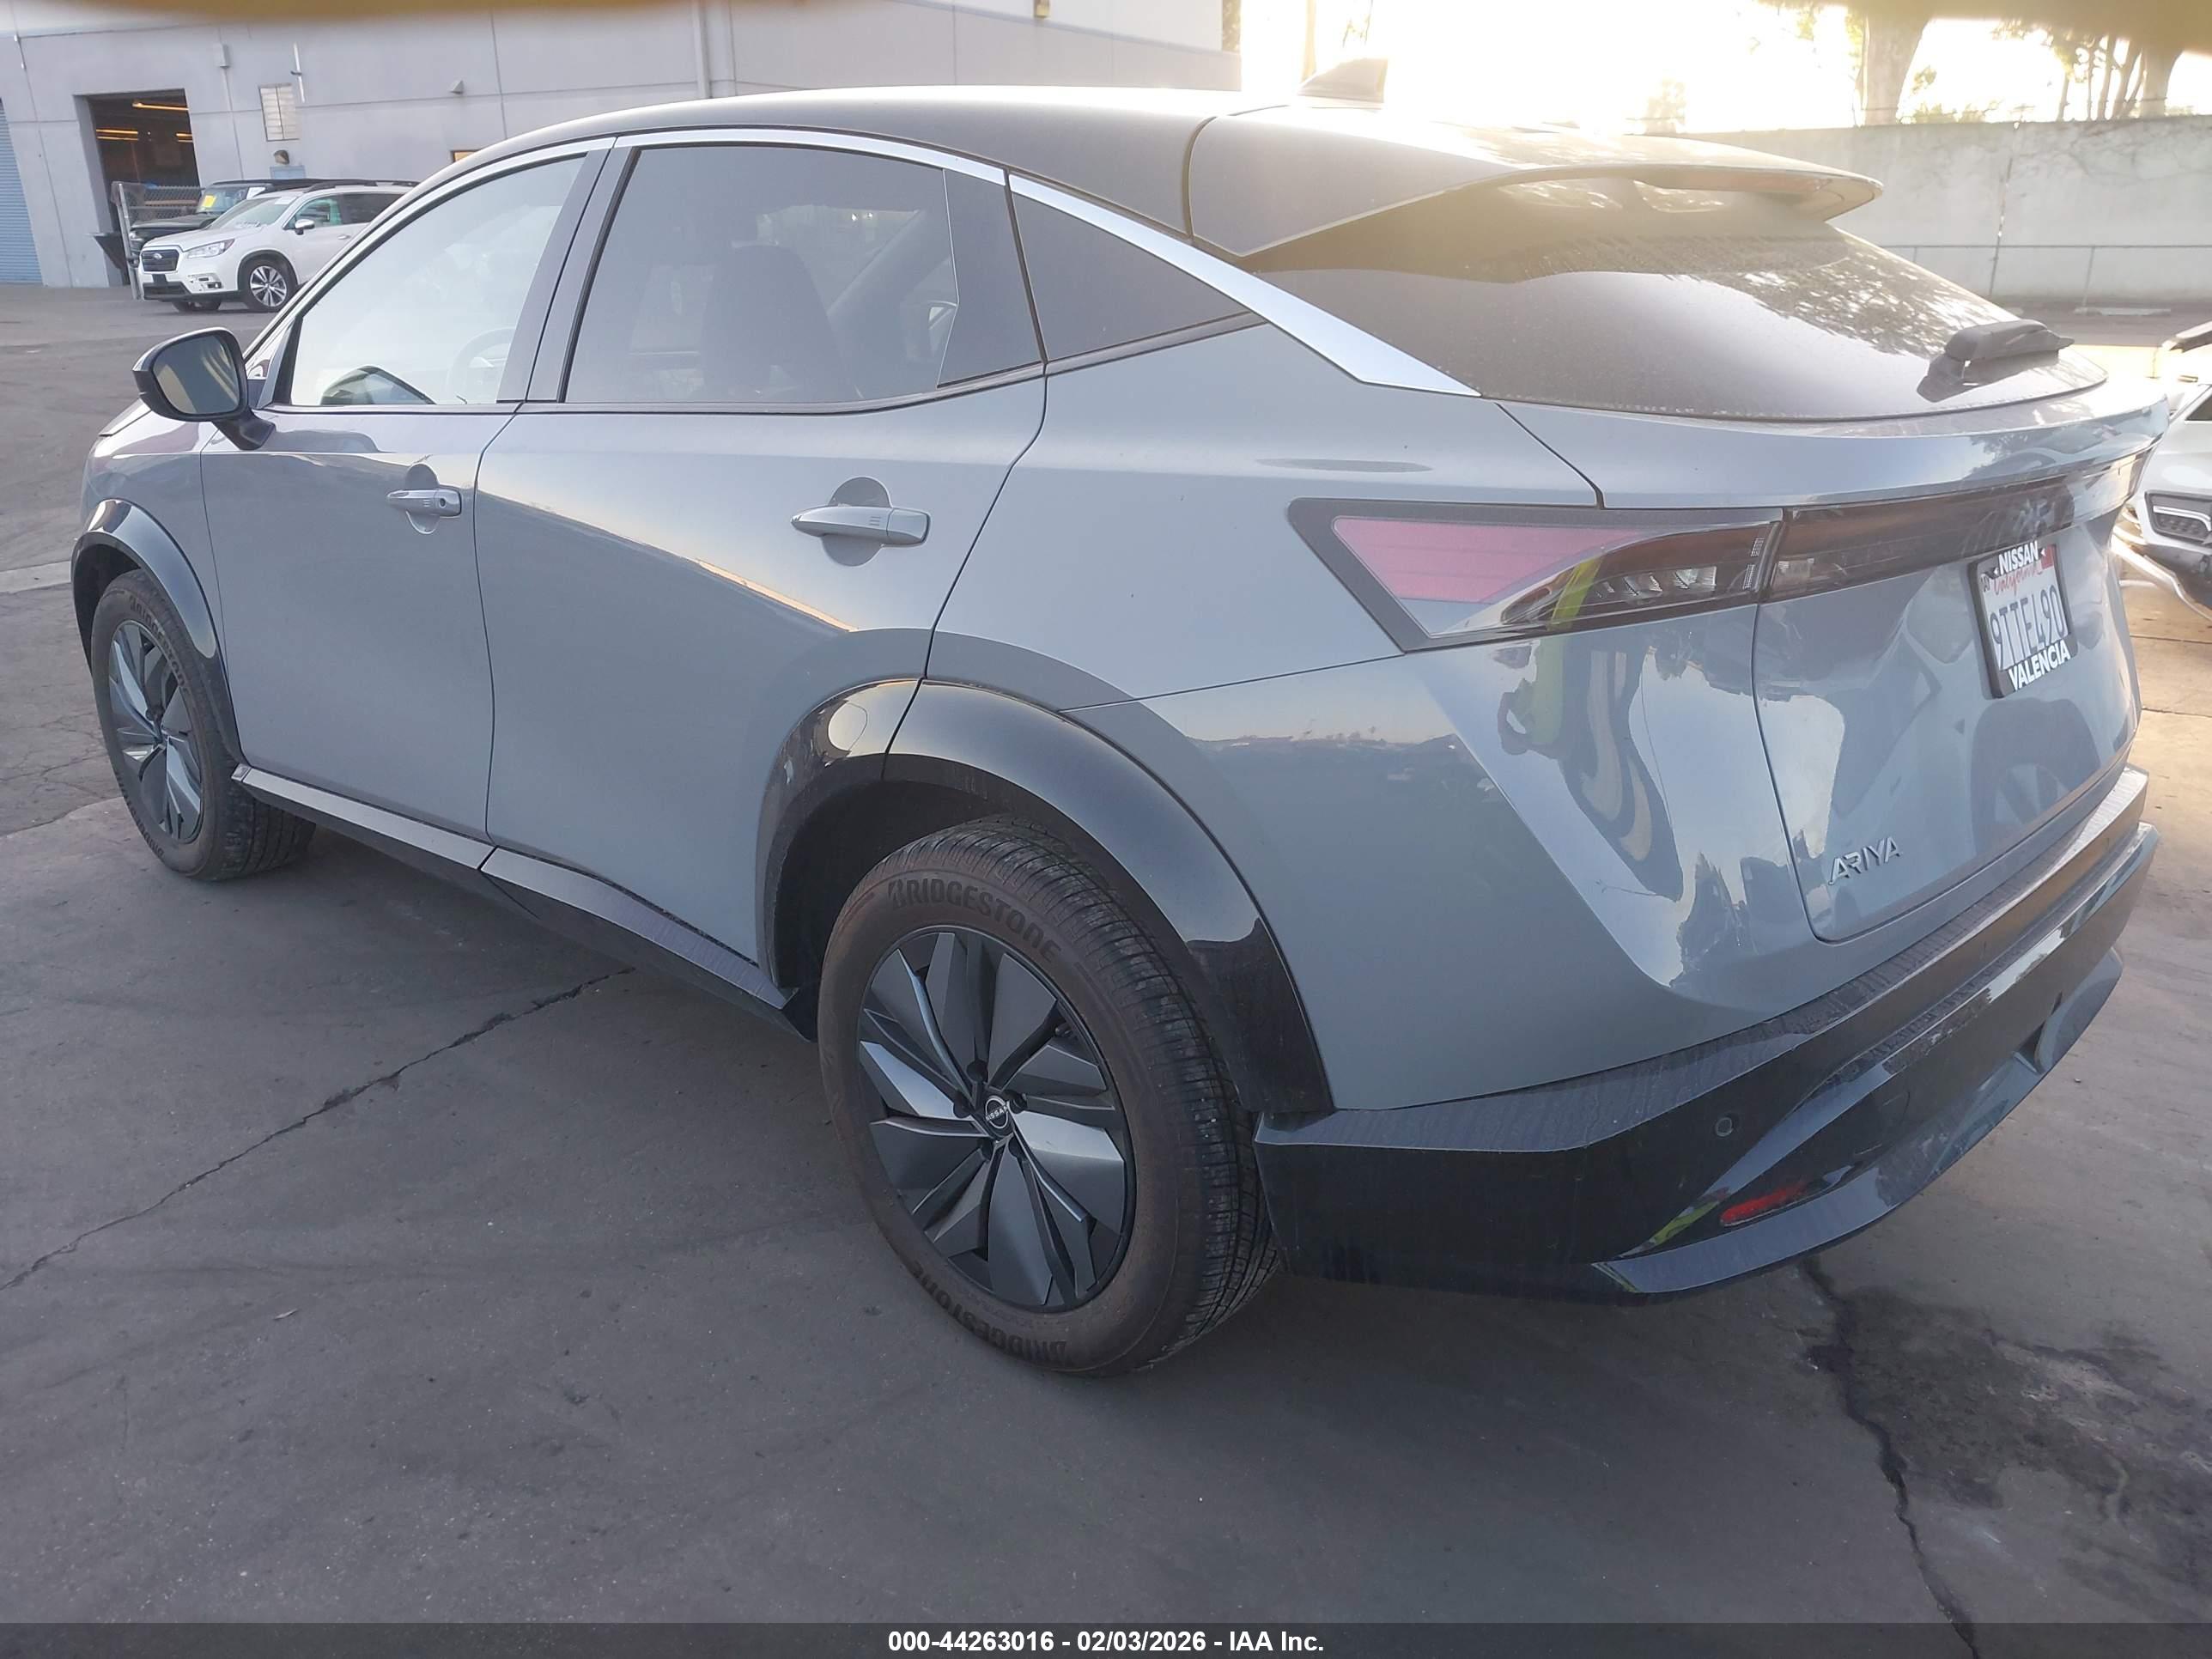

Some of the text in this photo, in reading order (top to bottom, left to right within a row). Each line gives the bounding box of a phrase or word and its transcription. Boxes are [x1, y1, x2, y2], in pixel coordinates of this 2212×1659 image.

[1998, 540, 2039, 575] NISSAN
[1990, 585, 2064, 671] 9TTE490
[2008, 640, 2071, 691] VALENCIA
[1828, 836, 1900, 885] ARIYA
[888, 878, 1062, 963] BRIDGESTONE
